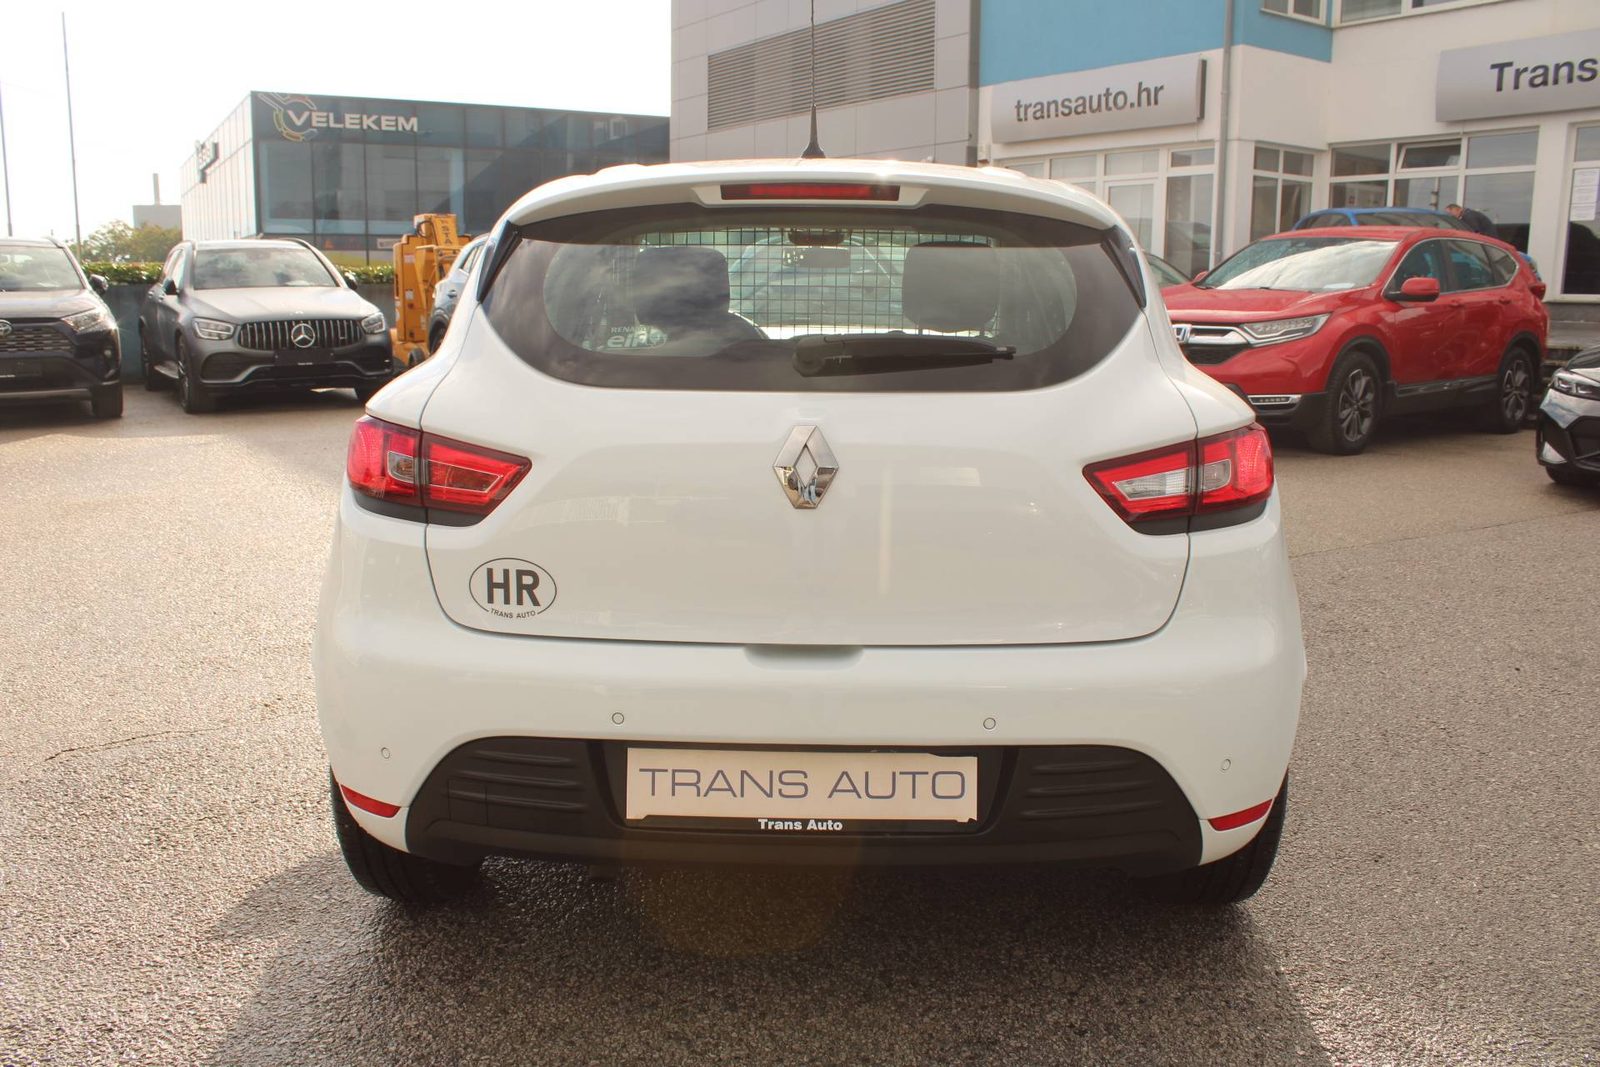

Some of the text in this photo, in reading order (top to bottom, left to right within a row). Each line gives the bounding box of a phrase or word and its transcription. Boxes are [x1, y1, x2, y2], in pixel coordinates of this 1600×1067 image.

[1489, 58, 1599, 92] Trans
[1015, 81, 1164, 122] transauto.hr
[287, 110, 418, 132] VELEKEM
[487, 567, 541, 607] HR
[490, 608, 536, 619] TRANS AUTO
[639, 768, 966, 800] TRANS AUTO
[758, 818, 843, 831] Trans Auto
